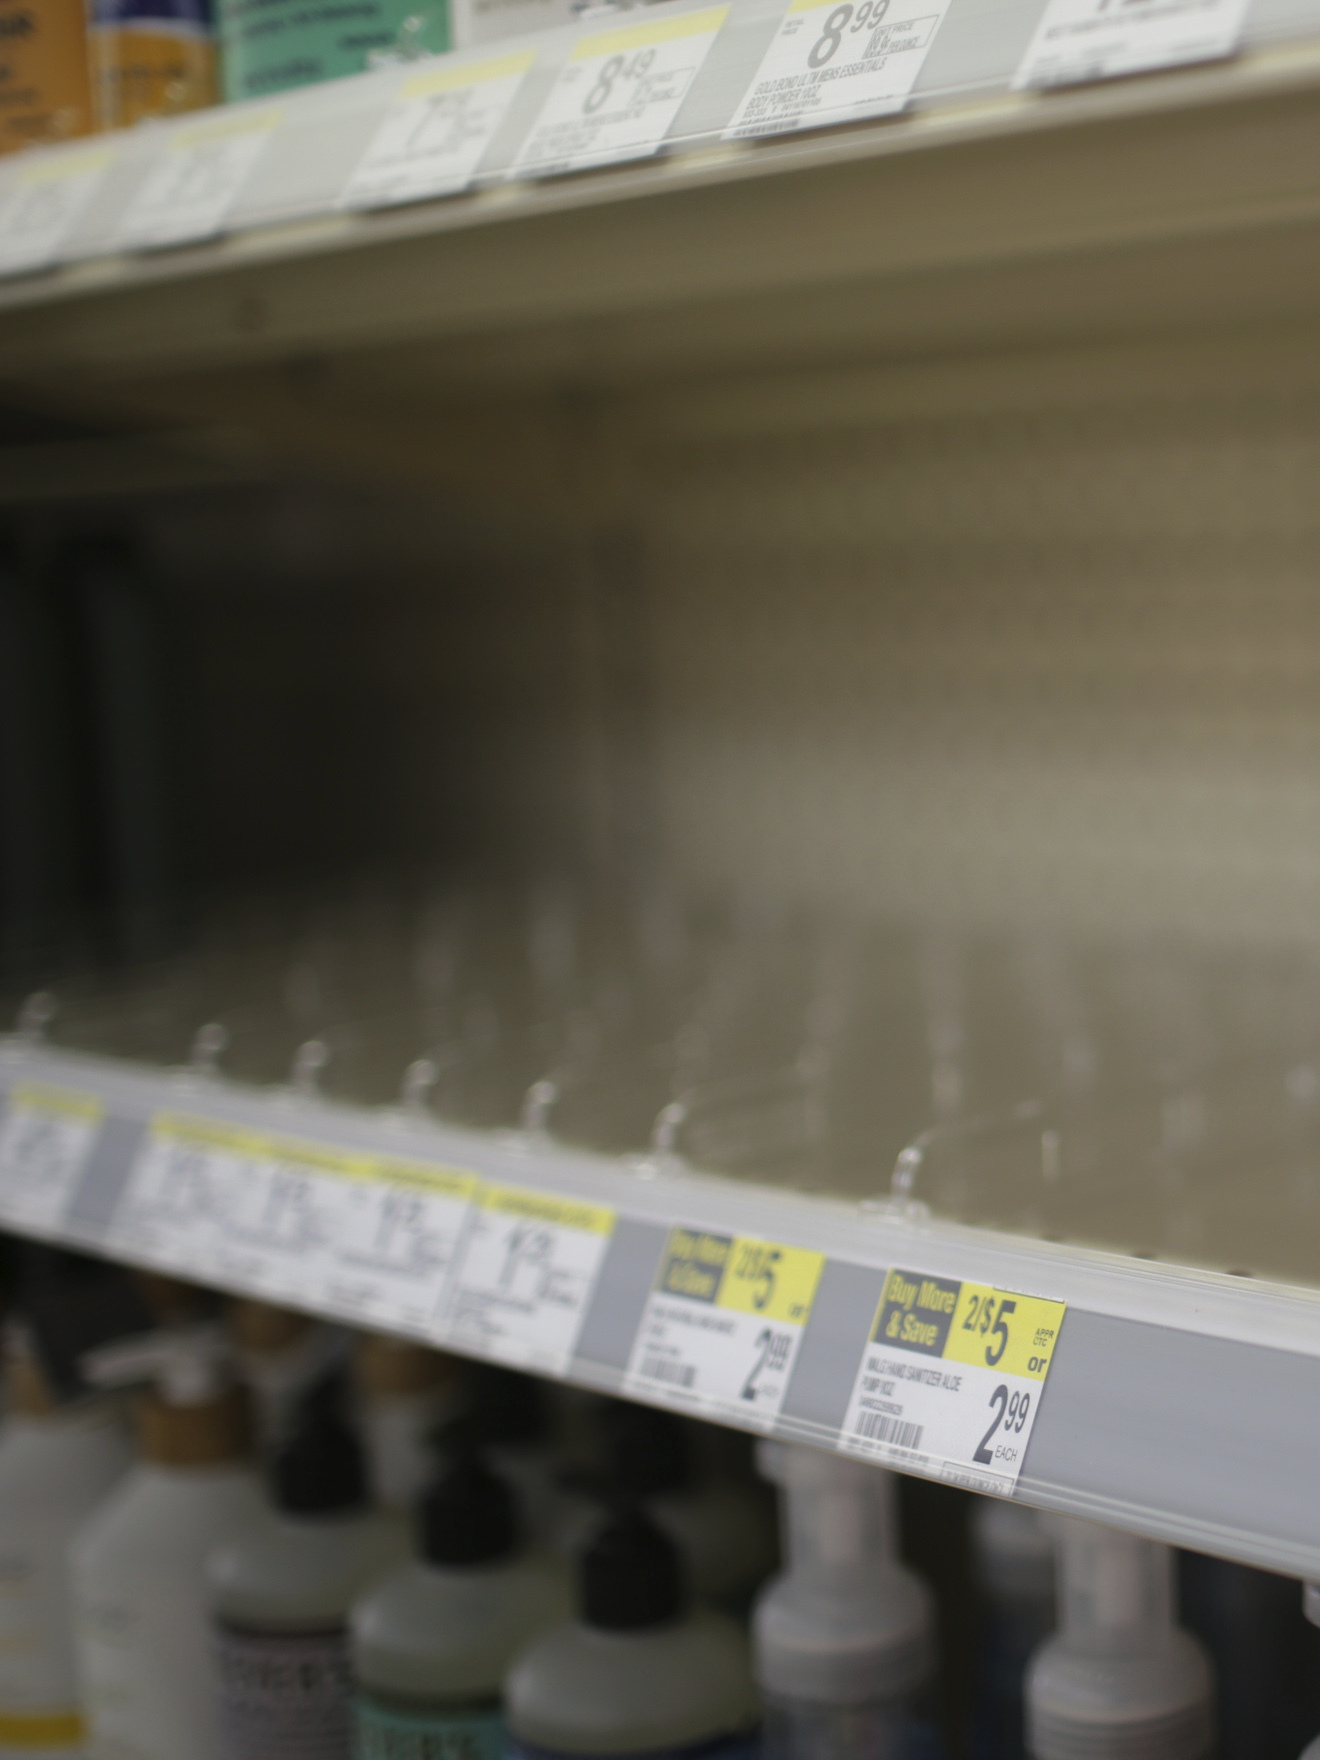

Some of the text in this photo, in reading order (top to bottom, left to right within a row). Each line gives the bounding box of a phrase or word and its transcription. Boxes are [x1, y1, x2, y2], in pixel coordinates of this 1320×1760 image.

[754, 79, 777, 95] GOLD
[776, 75, 799, 91] BOND
[840, 57, 887, 78] ESSENTIALS
[887, 1274, 919, 1311] Buy
[916, 1280, 957, 1314] More
[886, 1310, 939, 1346] & Save
[1034, 1328, 1055, 1340] APPR
[1033, 1336, 1048, 1347] CTC
[1027, 1355, 1048, 1373] or
[994, 1444, 1018, 1463] EACH
